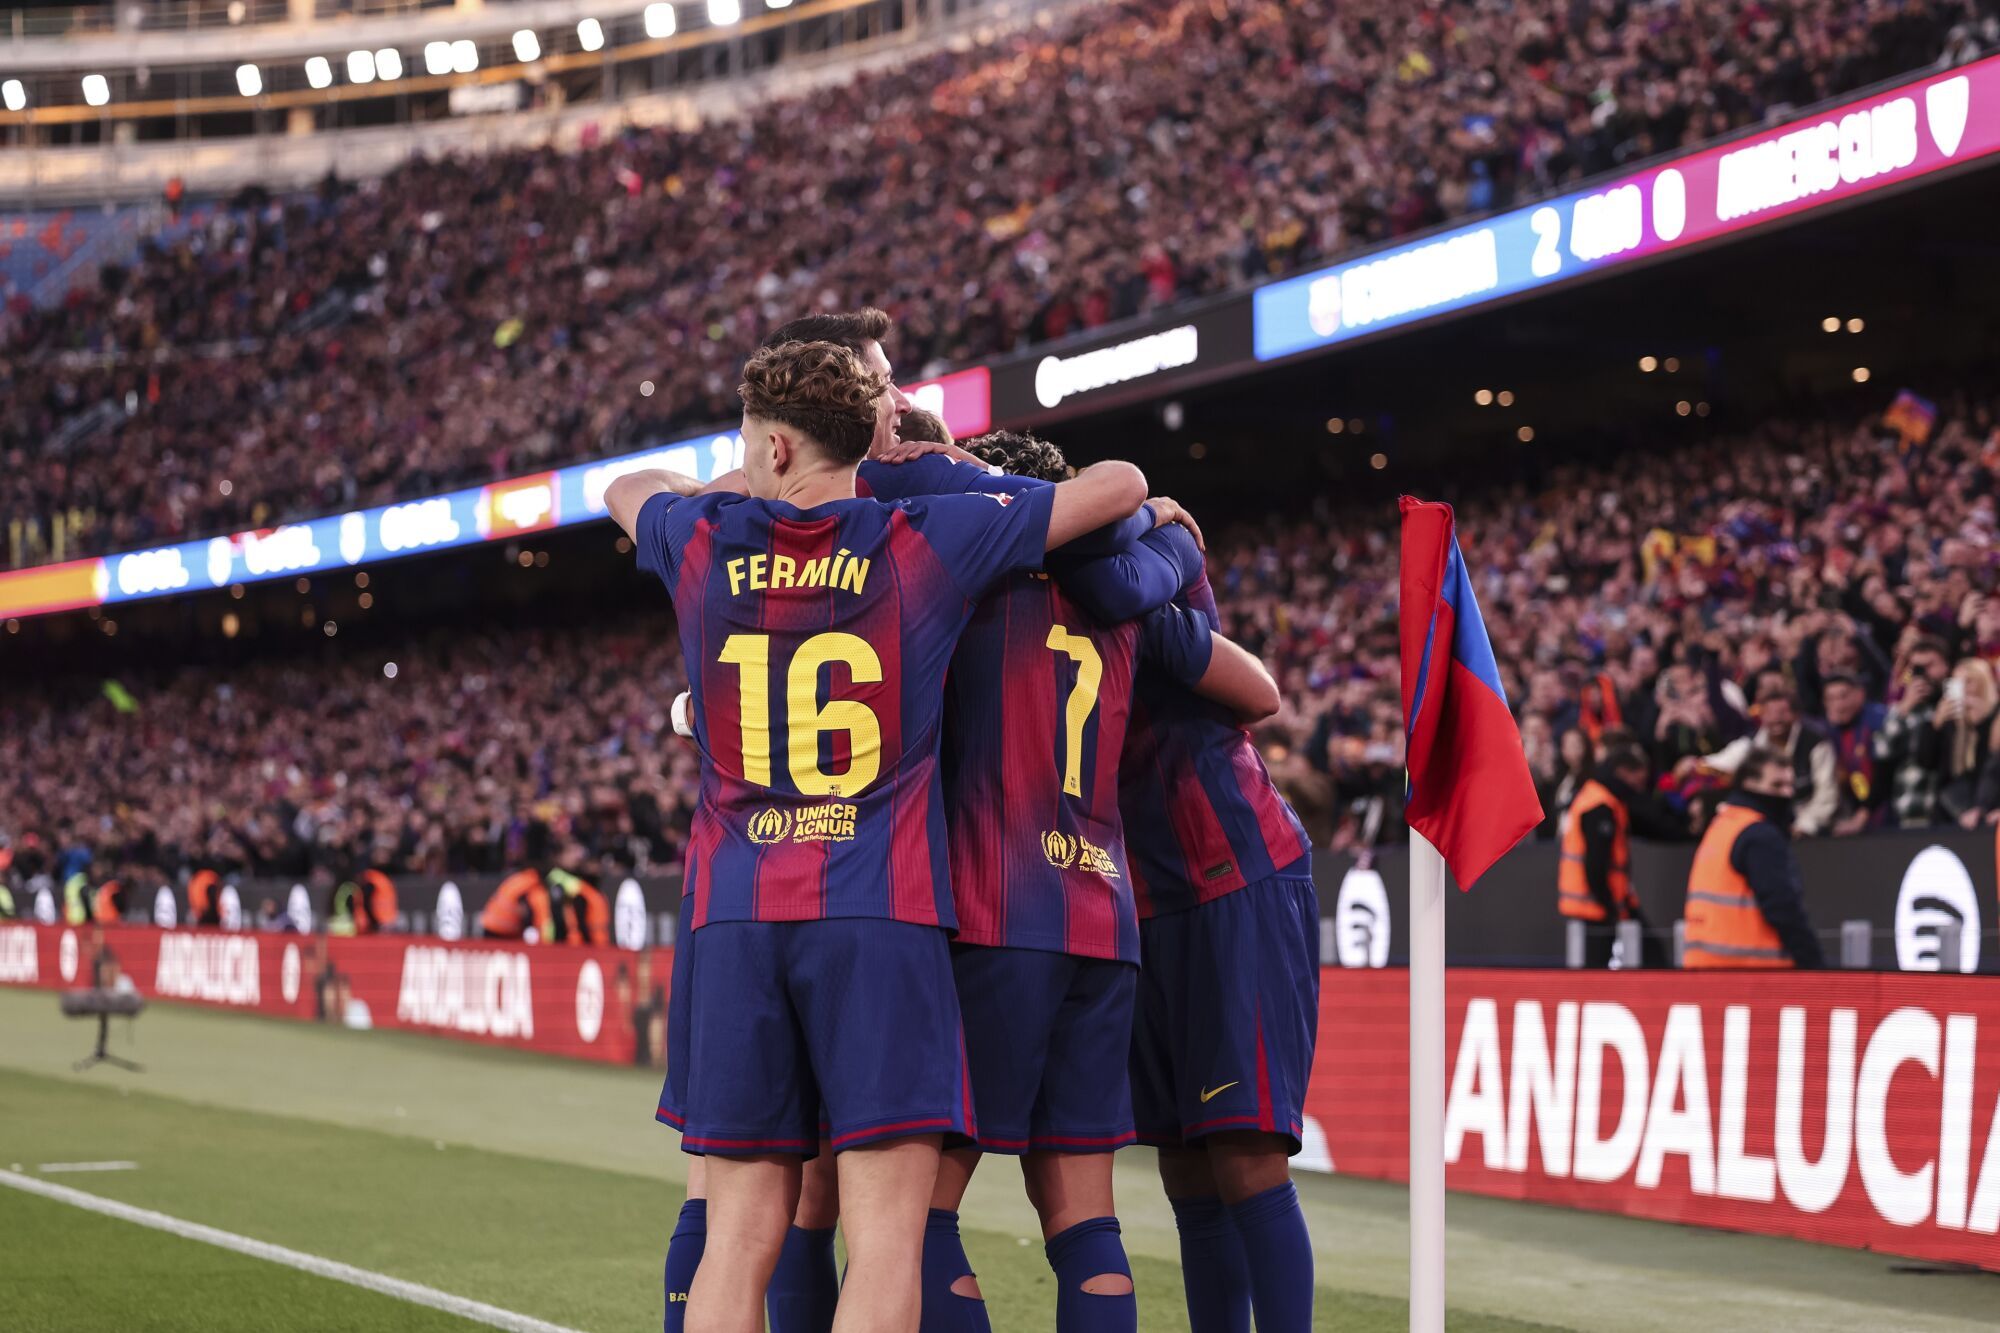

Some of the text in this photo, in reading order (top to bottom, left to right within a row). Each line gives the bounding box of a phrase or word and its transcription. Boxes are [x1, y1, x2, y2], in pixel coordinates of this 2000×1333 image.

[727, 548, 871, 596] FERMÍN
[717, 632, 883, 798] 16
[1046, 624, 1103, 798] 7
[793, 819, 855, 837] ACNUR
[795, 803, 858, 822] UNHCR
